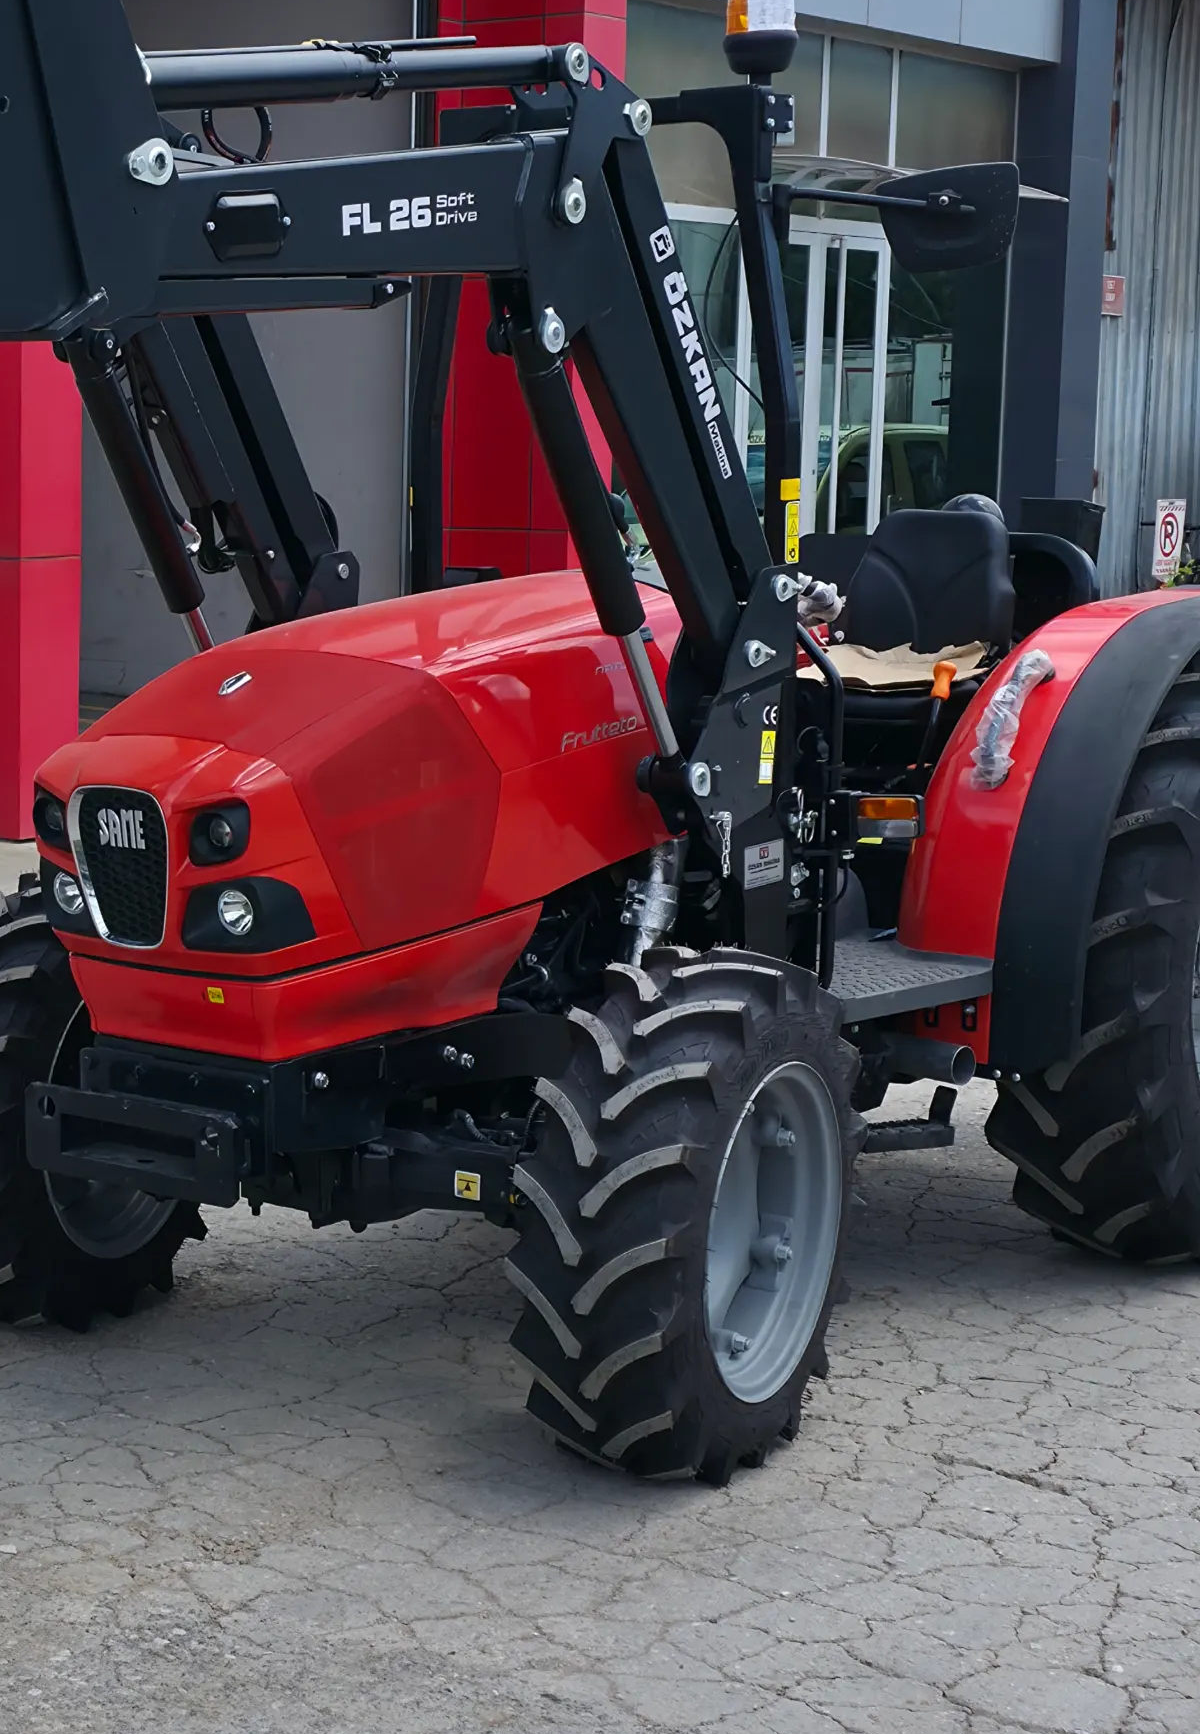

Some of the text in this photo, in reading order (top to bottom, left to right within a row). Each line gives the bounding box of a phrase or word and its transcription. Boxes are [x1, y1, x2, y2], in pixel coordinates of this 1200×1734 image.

[342, 196, 432, 236] FL 26
[435, 192, 475, 208] Soft
[435, 210, 478, 226] Drive
[663, 271, 730, 478] ÖZKAN Makina
[561, 716, 638, 753] Frutteto
[97, 808, 146, 850] SAME
